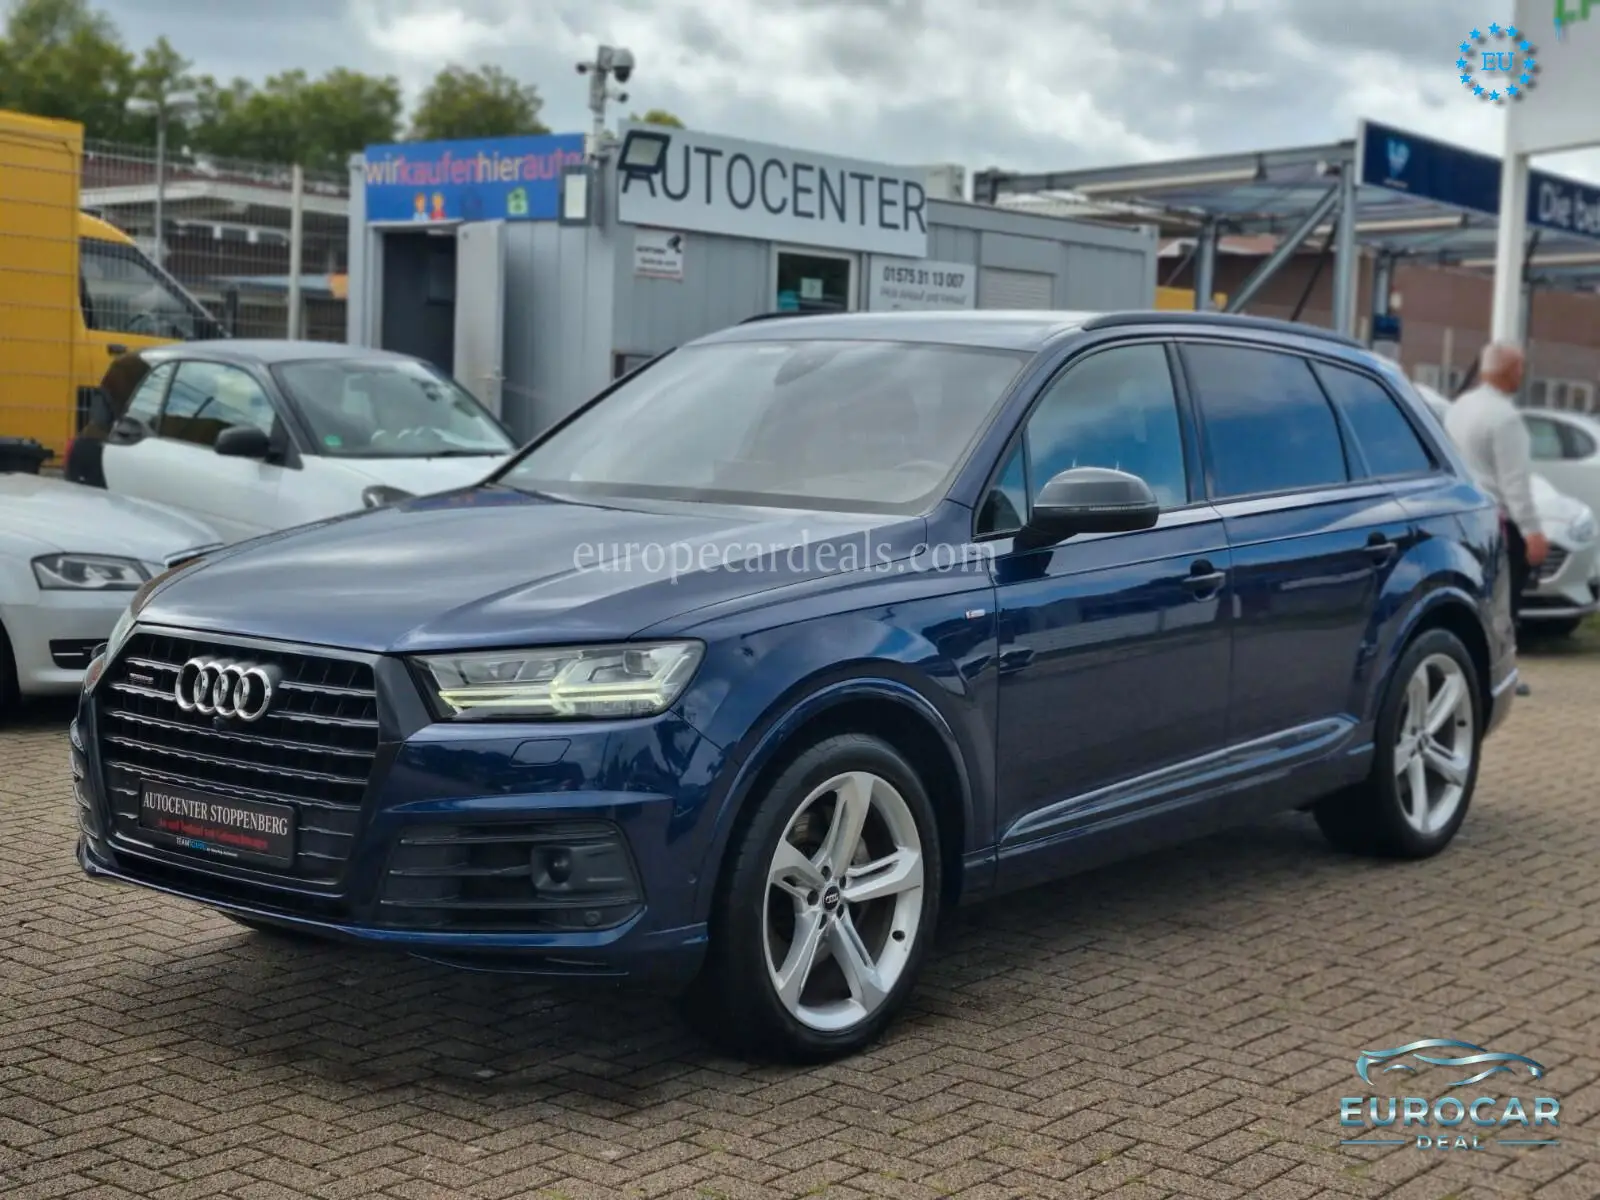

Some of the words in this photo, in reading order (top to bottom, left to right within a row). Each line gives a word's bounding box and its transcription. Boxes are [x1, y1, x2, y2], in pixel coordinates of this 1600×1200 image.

[1540, 182, 1571, 228] Die
[143, 791, 208, 821] AUTOCENTER
[210, 804, 288, 836] STOPPENBERG
